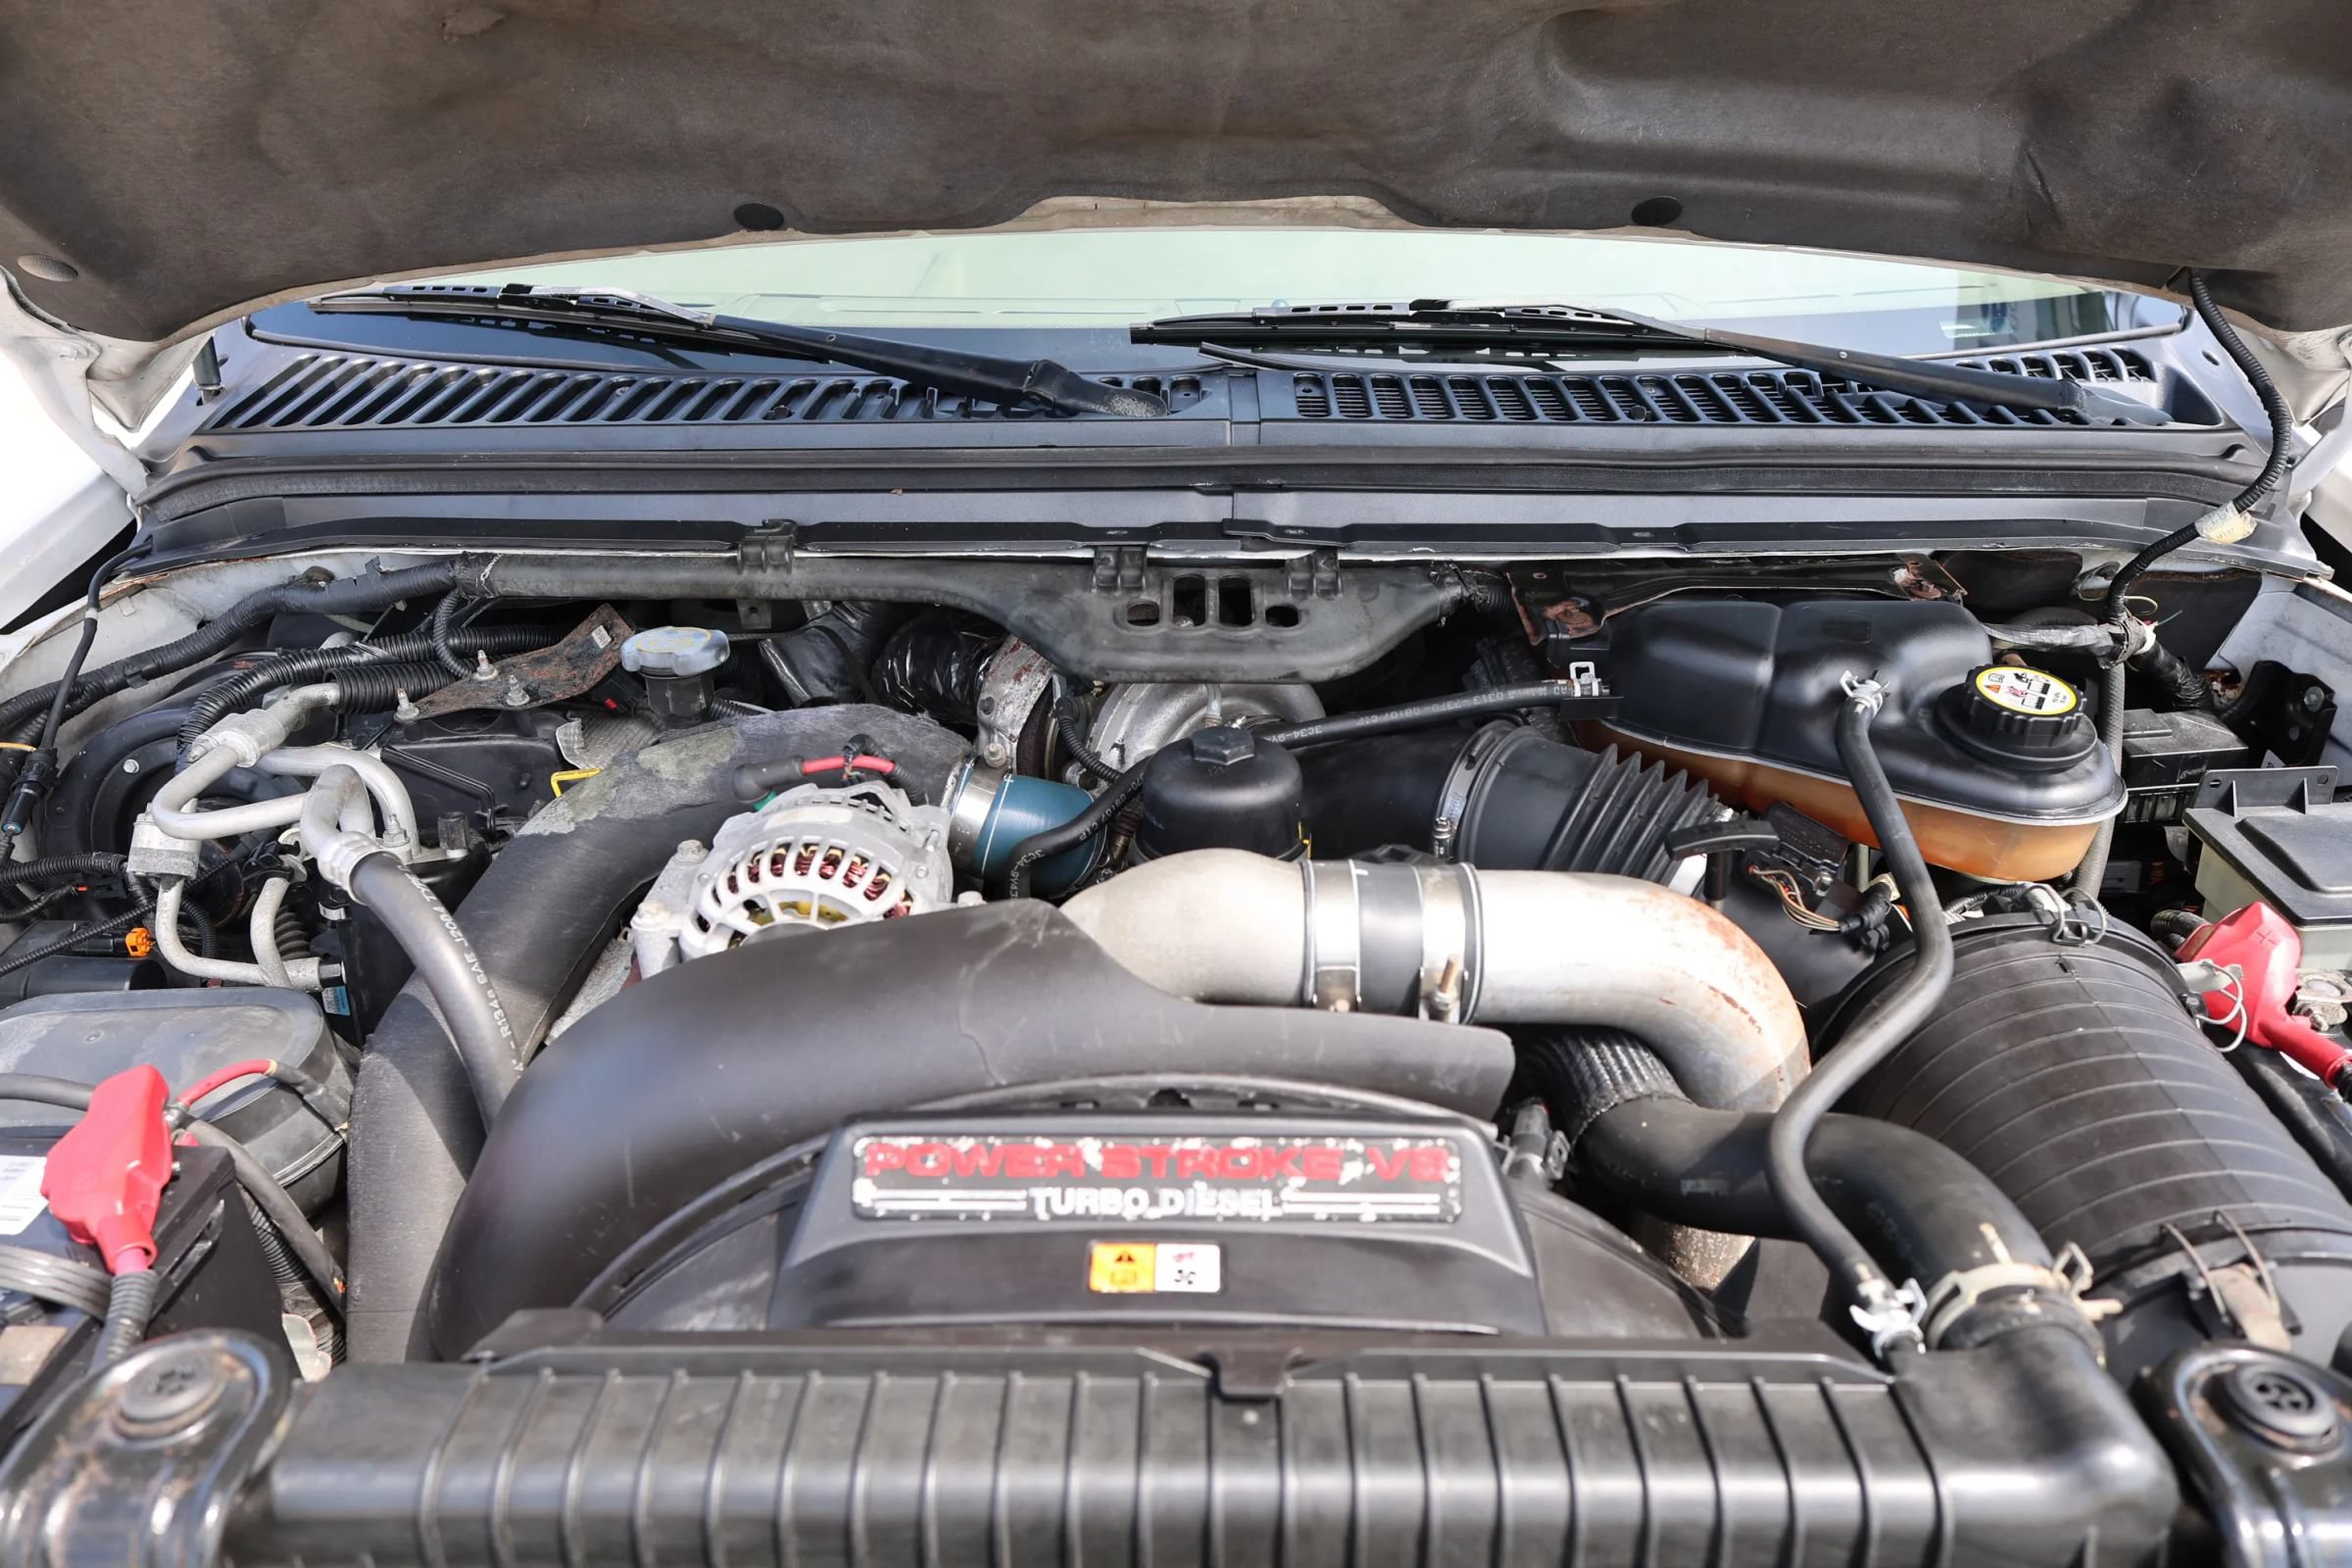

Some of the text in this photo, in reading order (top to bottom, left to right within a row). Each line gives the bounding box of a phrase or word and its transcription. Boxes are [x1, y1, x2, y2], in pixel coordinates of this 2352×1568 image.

[464, 951, 488, 985] SAE
[866, 1143, 1450, 1182] POWER STROKE V8
[1029, 1187, 1280, 1217] TURBO DIESEL
